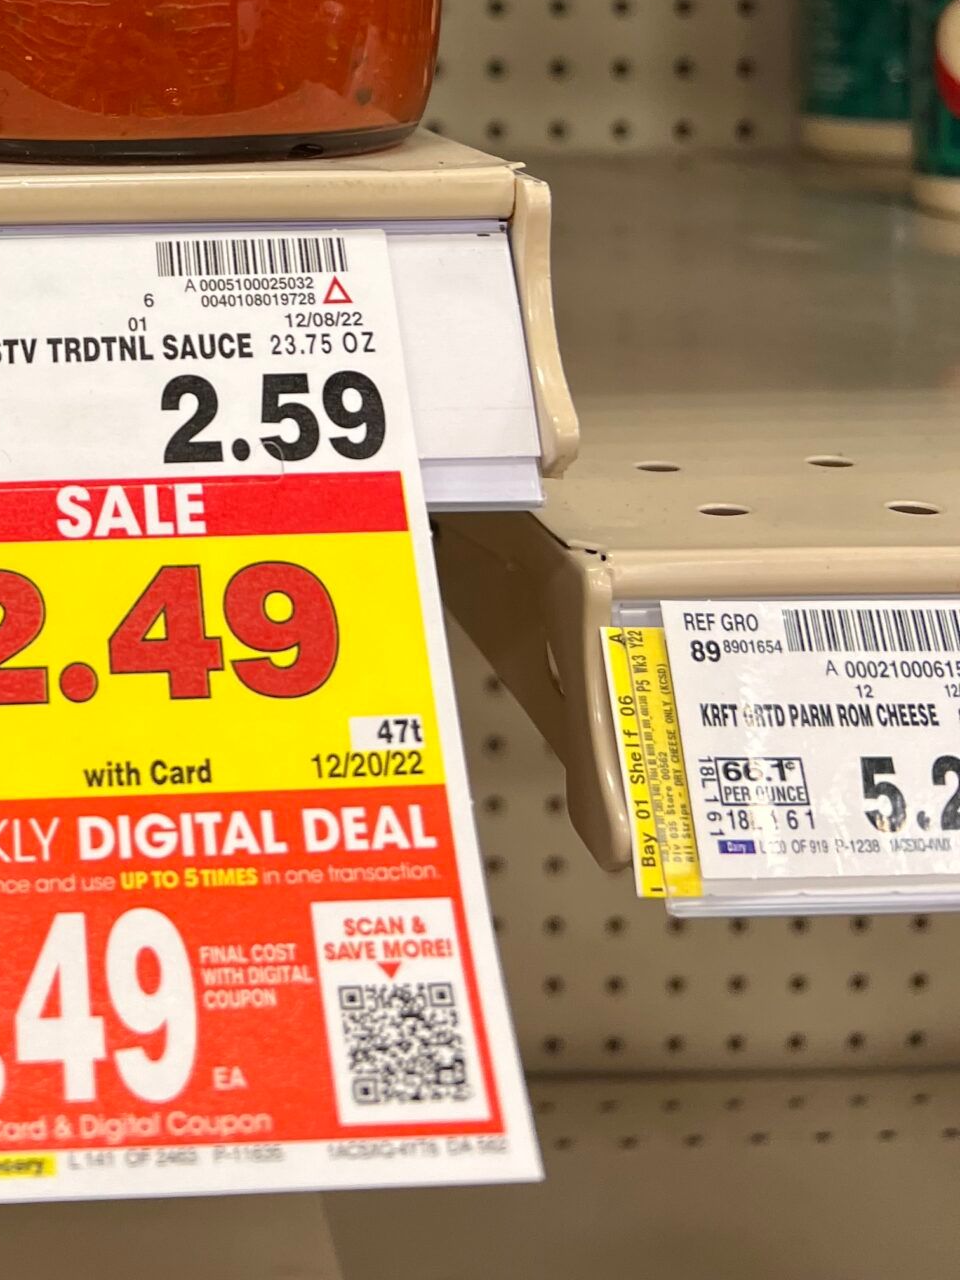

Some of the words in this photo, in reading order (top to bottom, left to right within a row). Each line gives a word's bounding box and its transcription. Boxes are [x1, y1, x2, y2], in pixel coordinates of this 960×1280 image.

[184, 281, 197, 293] A
[199, 276, 315, 293] 0005100025032
[143, 293, 155, 308] 6
[200, 292, 316, 309] 0040108019728
[128, 317, 147, 332] 01
[284, 311, 363, 329] 12/08/22
[47, 335, 154, 364] TRDTNL
[162, 333, 254, 361] SAUCE
[270, 334, 334, 356] 23.75
[342, 331, 376, 354] OZ
[160, 369, 386, 465] 2.59
[55, 483, 208, 538] SALE
[683, 612, 716, 632] REF
[721, 612, 759, 632] GRO
[690, 639, 721, 663] 89
[723, 639, 783, 654] 8901654
[825, 660, 839, 677] A
[855, 683, 875, 699] 12
[618, 694, 635, 717] 06
[700, 703, 739, 728] KRFT
[788, 703, 832, 728] PARM
[837, 703, 875, 728] ROM
[877, 703, 941, 728] CHEESE
[376, 718, 424, 746] 47t
[310, 750, 425, 780] 12/20/22
[624, 729, 646, 784] Shelf
[84, 760, 141, 787] with
[150, 758, 212, 786] Card
[724, 785, 751, 803] PER
[634, 798, 651, 820] 01
[786, 809, 800, 830] 6
[77, 809, 289, 862] DIGITAL
[301, 804, 439, 854] DEAL
[641, 831, 659, 867] Bay
[792, 839, 808, 854] OF
[809, 839, 829, 854] 919
[34, 872, 77, 893] and
[80, 875, 117, 892] use
[120, 871, 148, 891] UP
[152, 870, 179, 889] TO
[183, 868, 200, 888] 5
[201, 867, 258, 888] TIMES
[262, 868, 281, 886] in
[285, 869, 324, 886] one
[327, 862, 441, 883] transaction.
[343, 916, 404, 937] SCAN
[411, 915, 428, 935] &
[198, 944, 248, 965] FINAL
[250, 942, 297, 963] COST
[324, 941, 376, 962] SAVE
[382, 938, 453, 959] MORE!
[201, 967, 245, 987] WITH
[247, 964, 314, 985] DIGITAL
[203, 988, 277, 1010] COUPON
[212, 1066, 249, 1091] EA
[53, 1114, 73, 1140] &
[79, 1111, 161, 1144] Digital
[165, 1110, 273, 1140] Coupon
